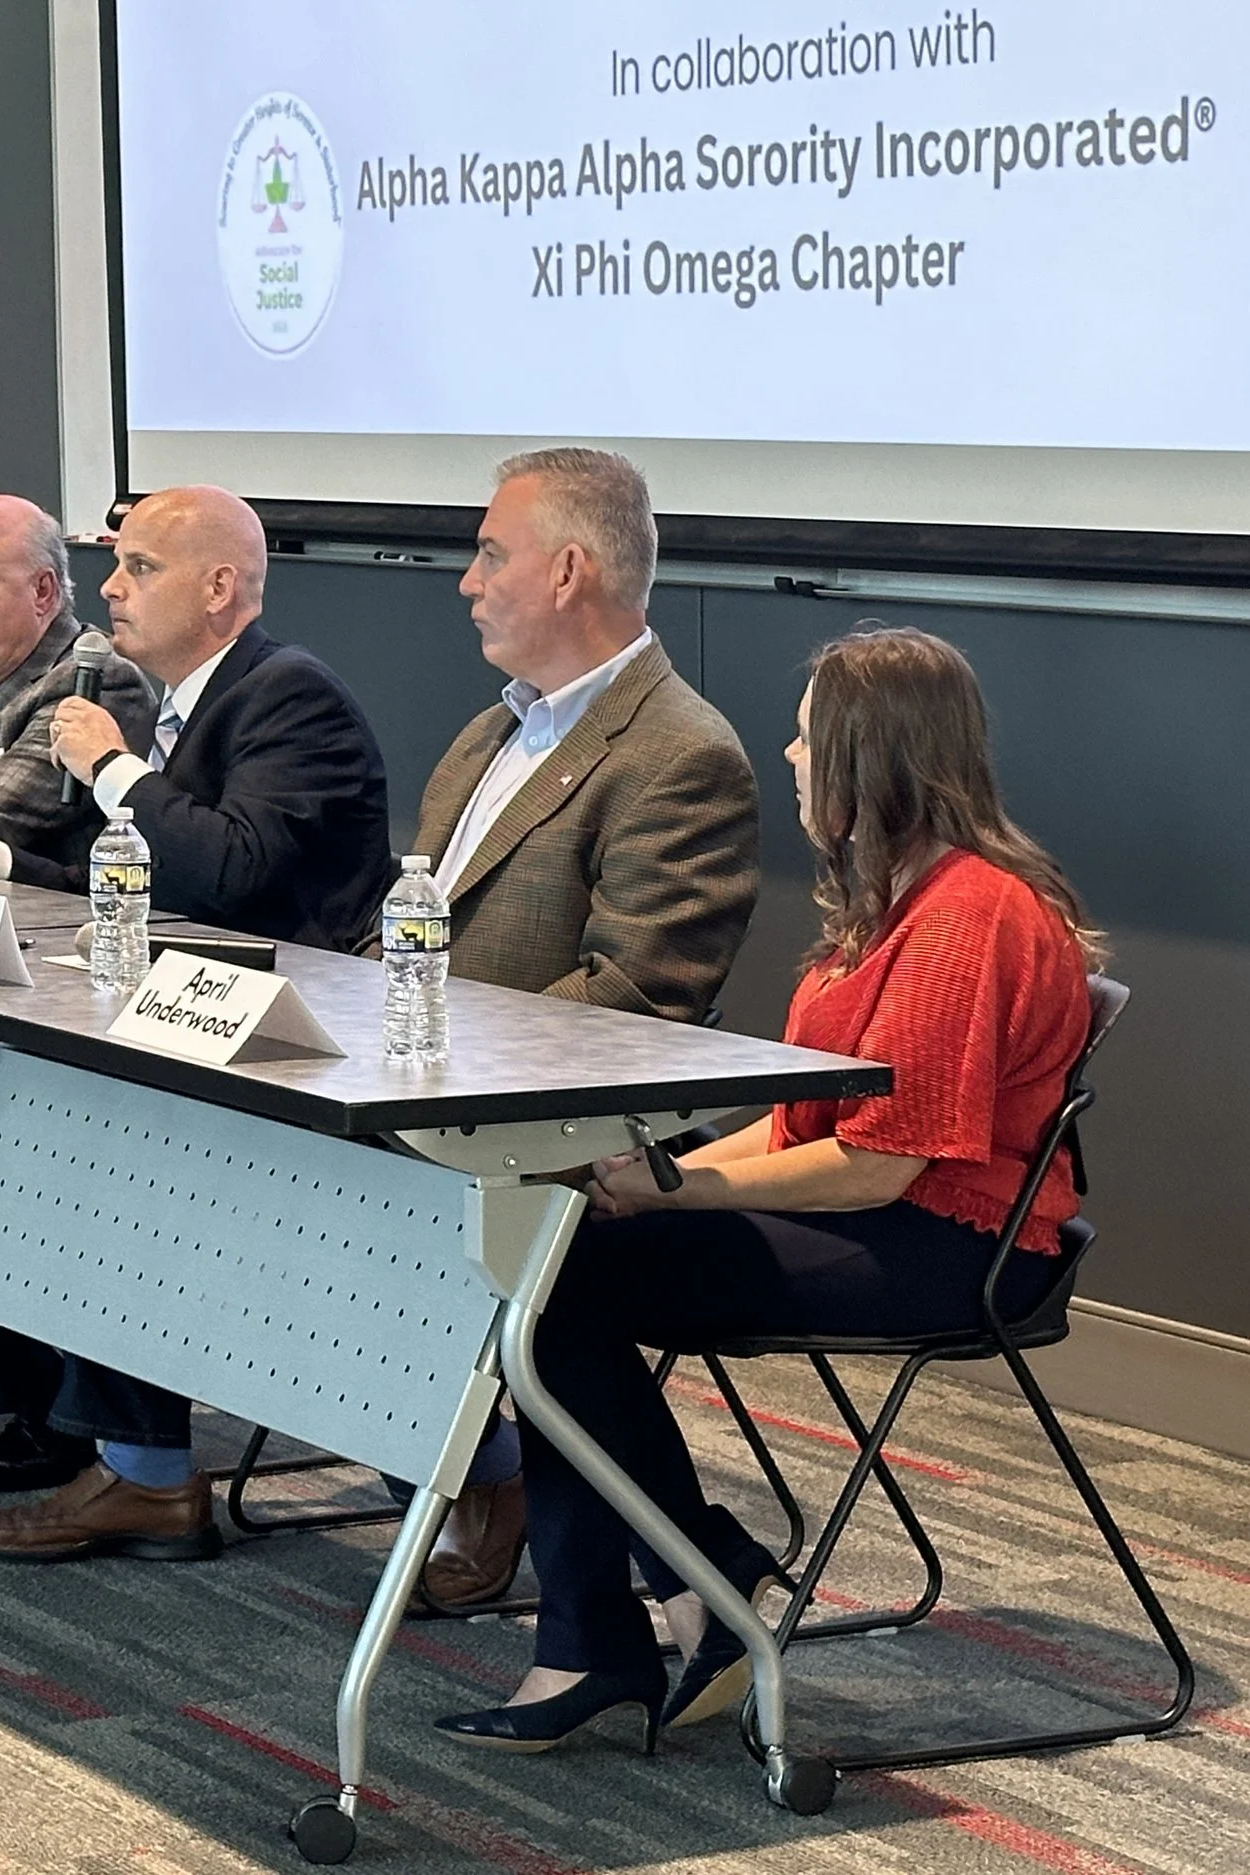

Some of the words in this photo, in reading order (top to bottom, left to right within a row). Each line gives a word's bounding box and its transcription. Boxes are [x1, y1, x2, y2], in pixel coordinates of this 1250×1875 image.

[612, 49, 640, 97] In
[651, 21, 897, 93] collaboration
[908, 8, 996, 69] with
[357, 154, 449, 223] Alpha
[460, 152, 567, 217] Kappa
[576, 136, 686, 211] Alpha
[696, 122, 862, 199] Sorority
[259, 261, 298, 284] Social
[531, 242, 563, 298] Xi
[575, 239, 631, 297] Phi
[643, 240, 781, 309] Omega
[792, 230, 965, 306] Chapter
[256, 286, 303, 310] Justice
[182, 967, 240, 1003] April
[136, 989, 248, 1039] Underwood
